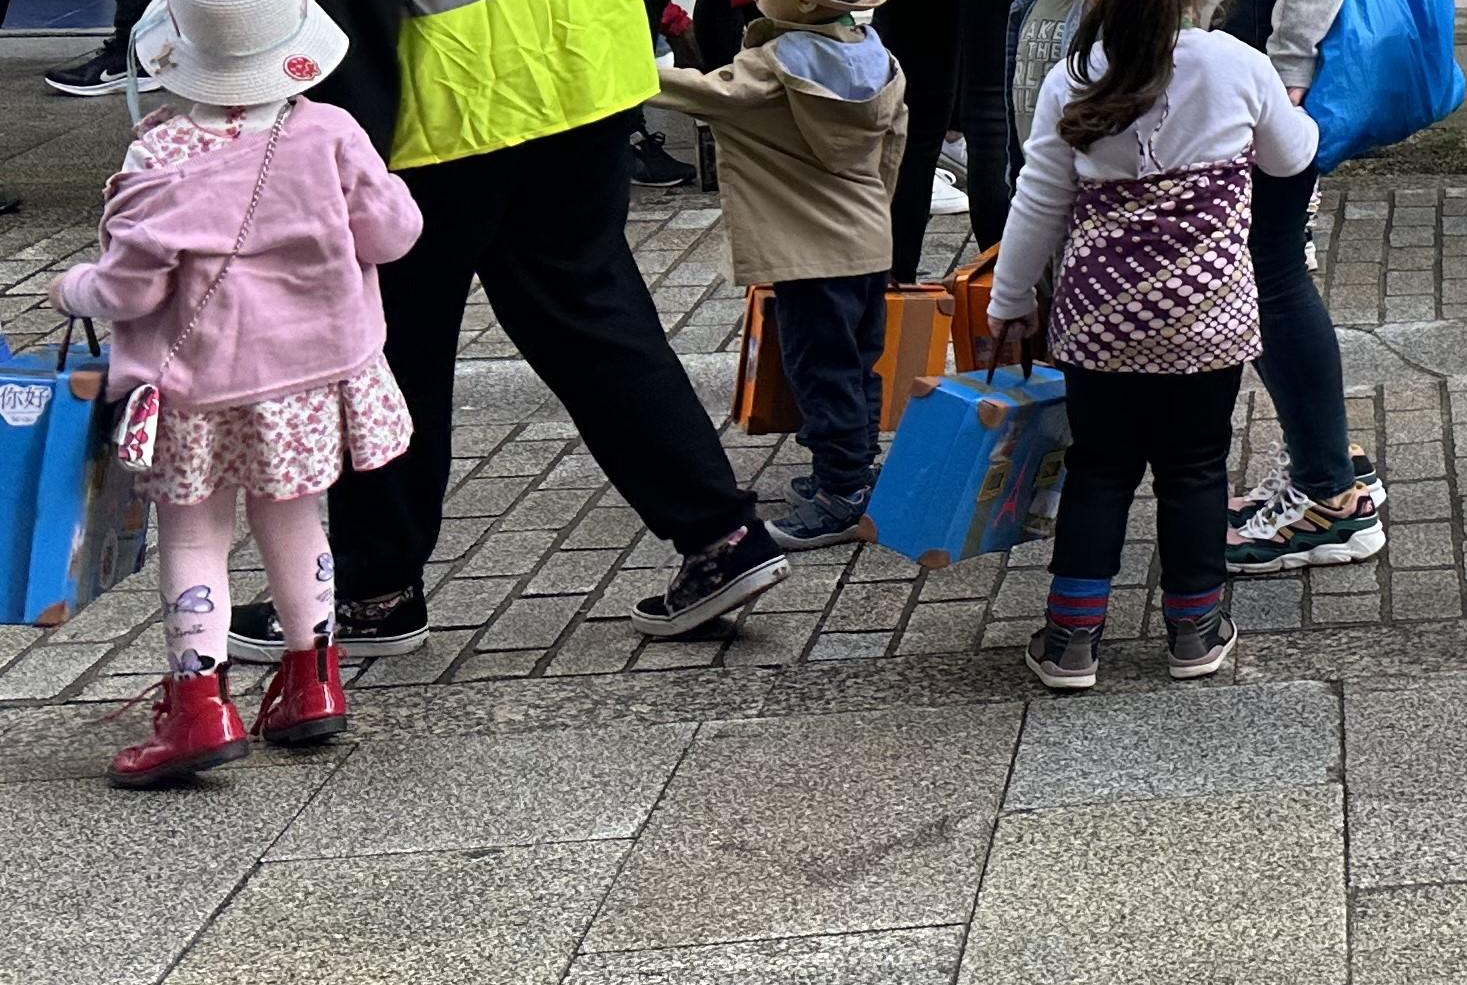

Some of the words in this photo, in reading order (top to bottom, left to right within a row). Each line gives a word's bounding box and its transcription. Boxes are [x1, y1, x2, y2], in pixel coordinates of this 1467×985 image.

[1021, 21, 1065, 39] AKE
[1028, 42, 1060, 59] THE
[1, 386, 49, 409] 你好
